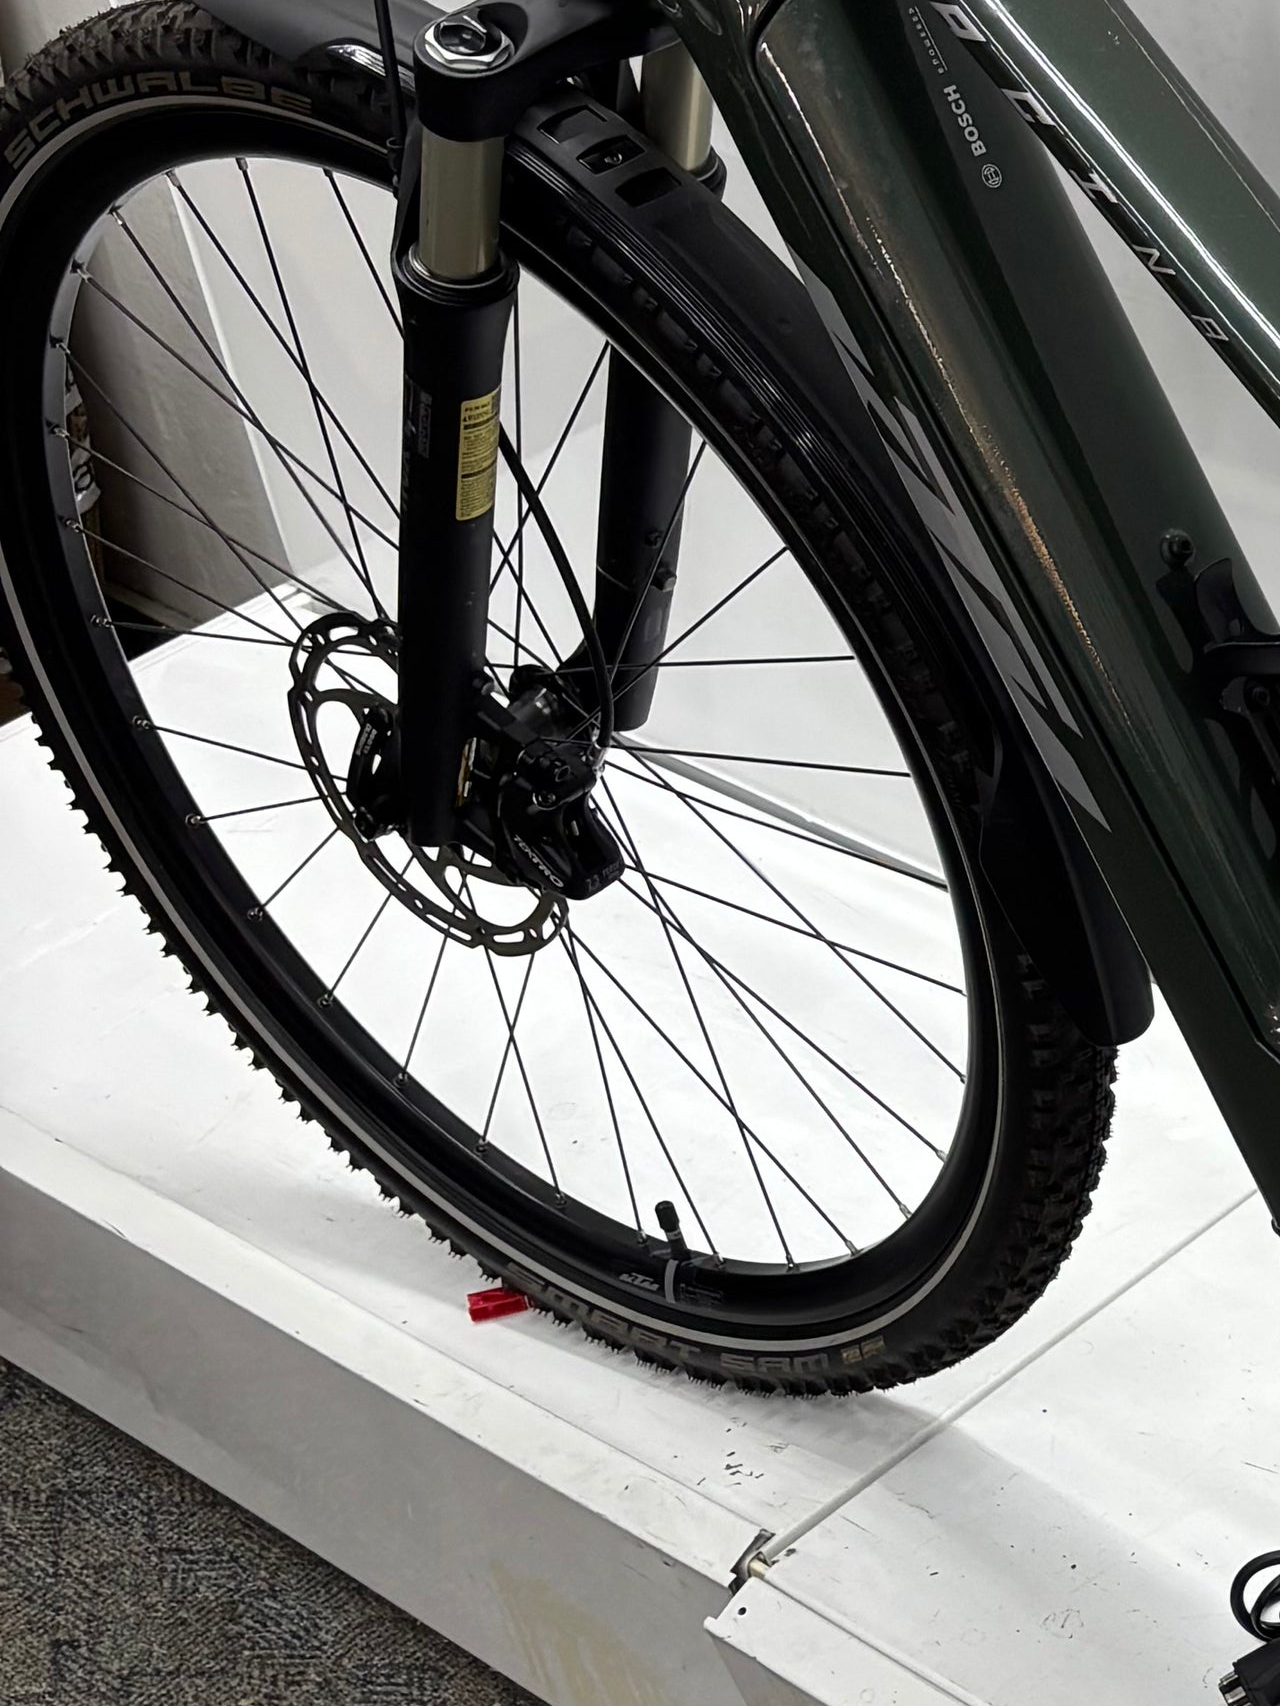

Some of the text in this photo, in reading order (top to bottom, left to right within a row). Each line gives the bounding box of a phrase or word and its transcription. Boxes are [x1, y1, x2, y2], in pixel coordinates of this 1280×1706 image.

[2, 71, 314, 171] SCHWALBE
[943, 84, 987, 157] BOSCH
[506, 1262, 829, 1375] SMART SAM
